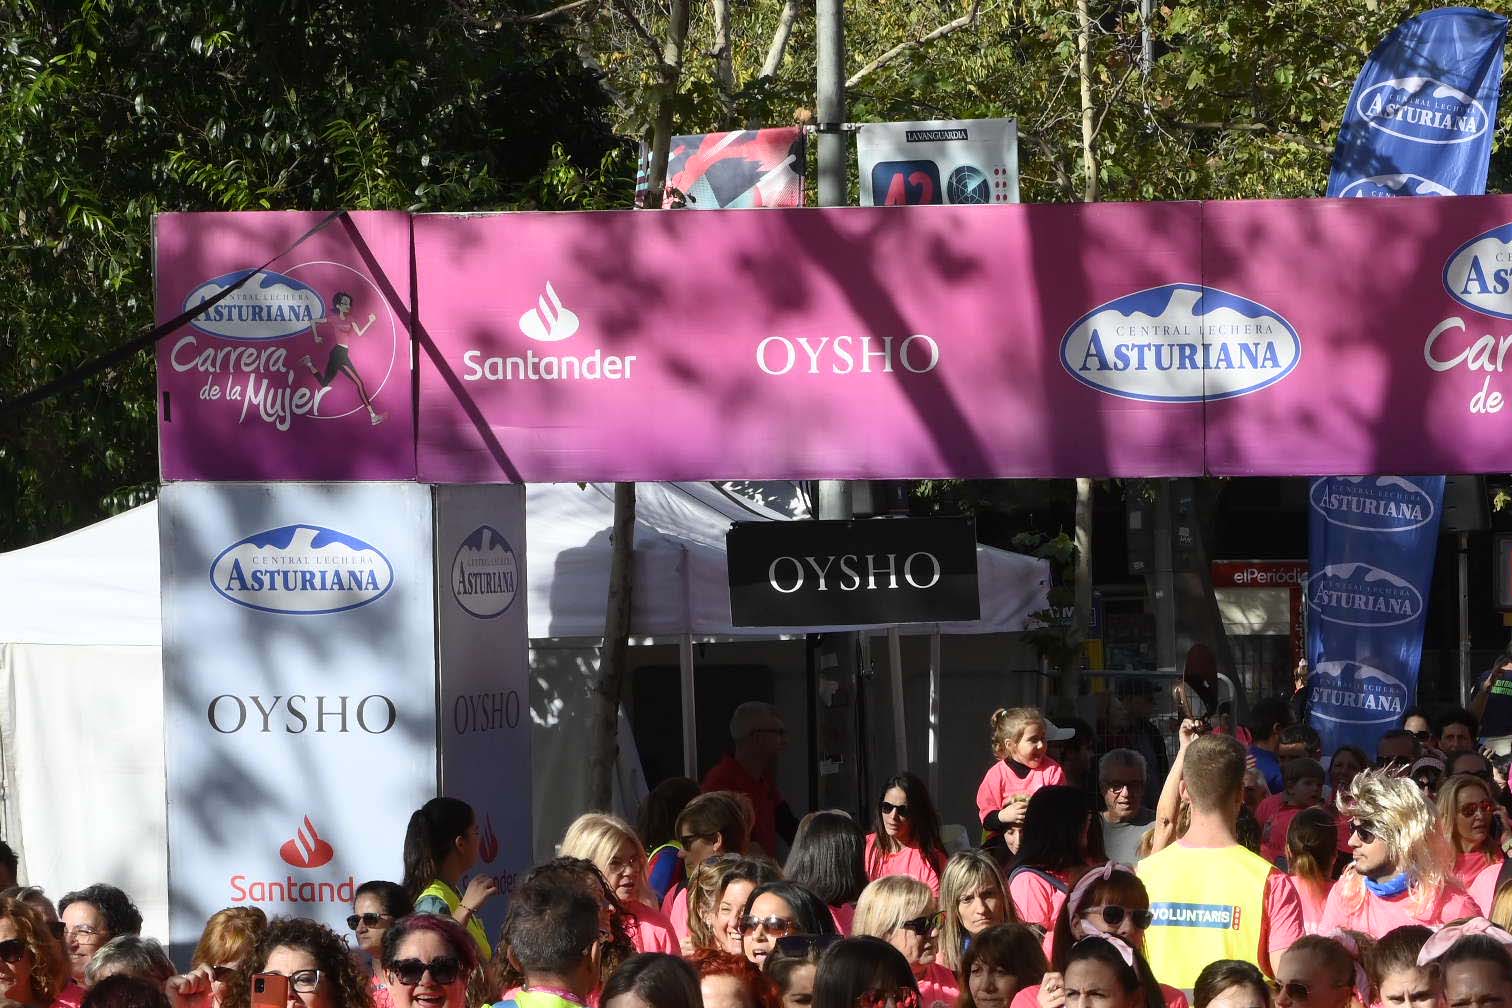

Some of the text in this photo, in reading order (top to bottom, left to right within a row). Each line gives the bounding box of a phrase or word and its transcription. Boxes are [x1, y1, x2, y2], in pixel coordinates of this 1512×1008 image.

[1365, 93, 1477, 133] ASTURIANA
[196, 295, 313, 322] ASTURIANA
[1116, 324, 1274, 337] CENTRAL LECHERA
[170, 335, 290, 373] Carrera
[463, 349, 637, 383] Santander
[755, 335, 940, 376] OYSHO
[1078, 327, 1280, 373] ASTURIANA
[200, 370, 332, 431] de la Mujer
[1469, 375, 1504, 413] de
[1319, 484, 1424, 521] ASTURIANA
[224, 557, 381, 592] ASTURIANA
[252, 555, 312, 565] CENTRAL
[768, 550, 942, 594] OYSHO
[457, 562, 515, 596] ASTURIANA
[1313, 581, 1413, 616] ASTURIANA
[206, 693, 398, 735] OYSHO
[455, 690, 520, 735] OYSHO
[1311, 686, 1402, 713] STURIANA
[229, 875, 362, 903] Santand
[1150, 908, 1230, 923] VOLUNTARIS
